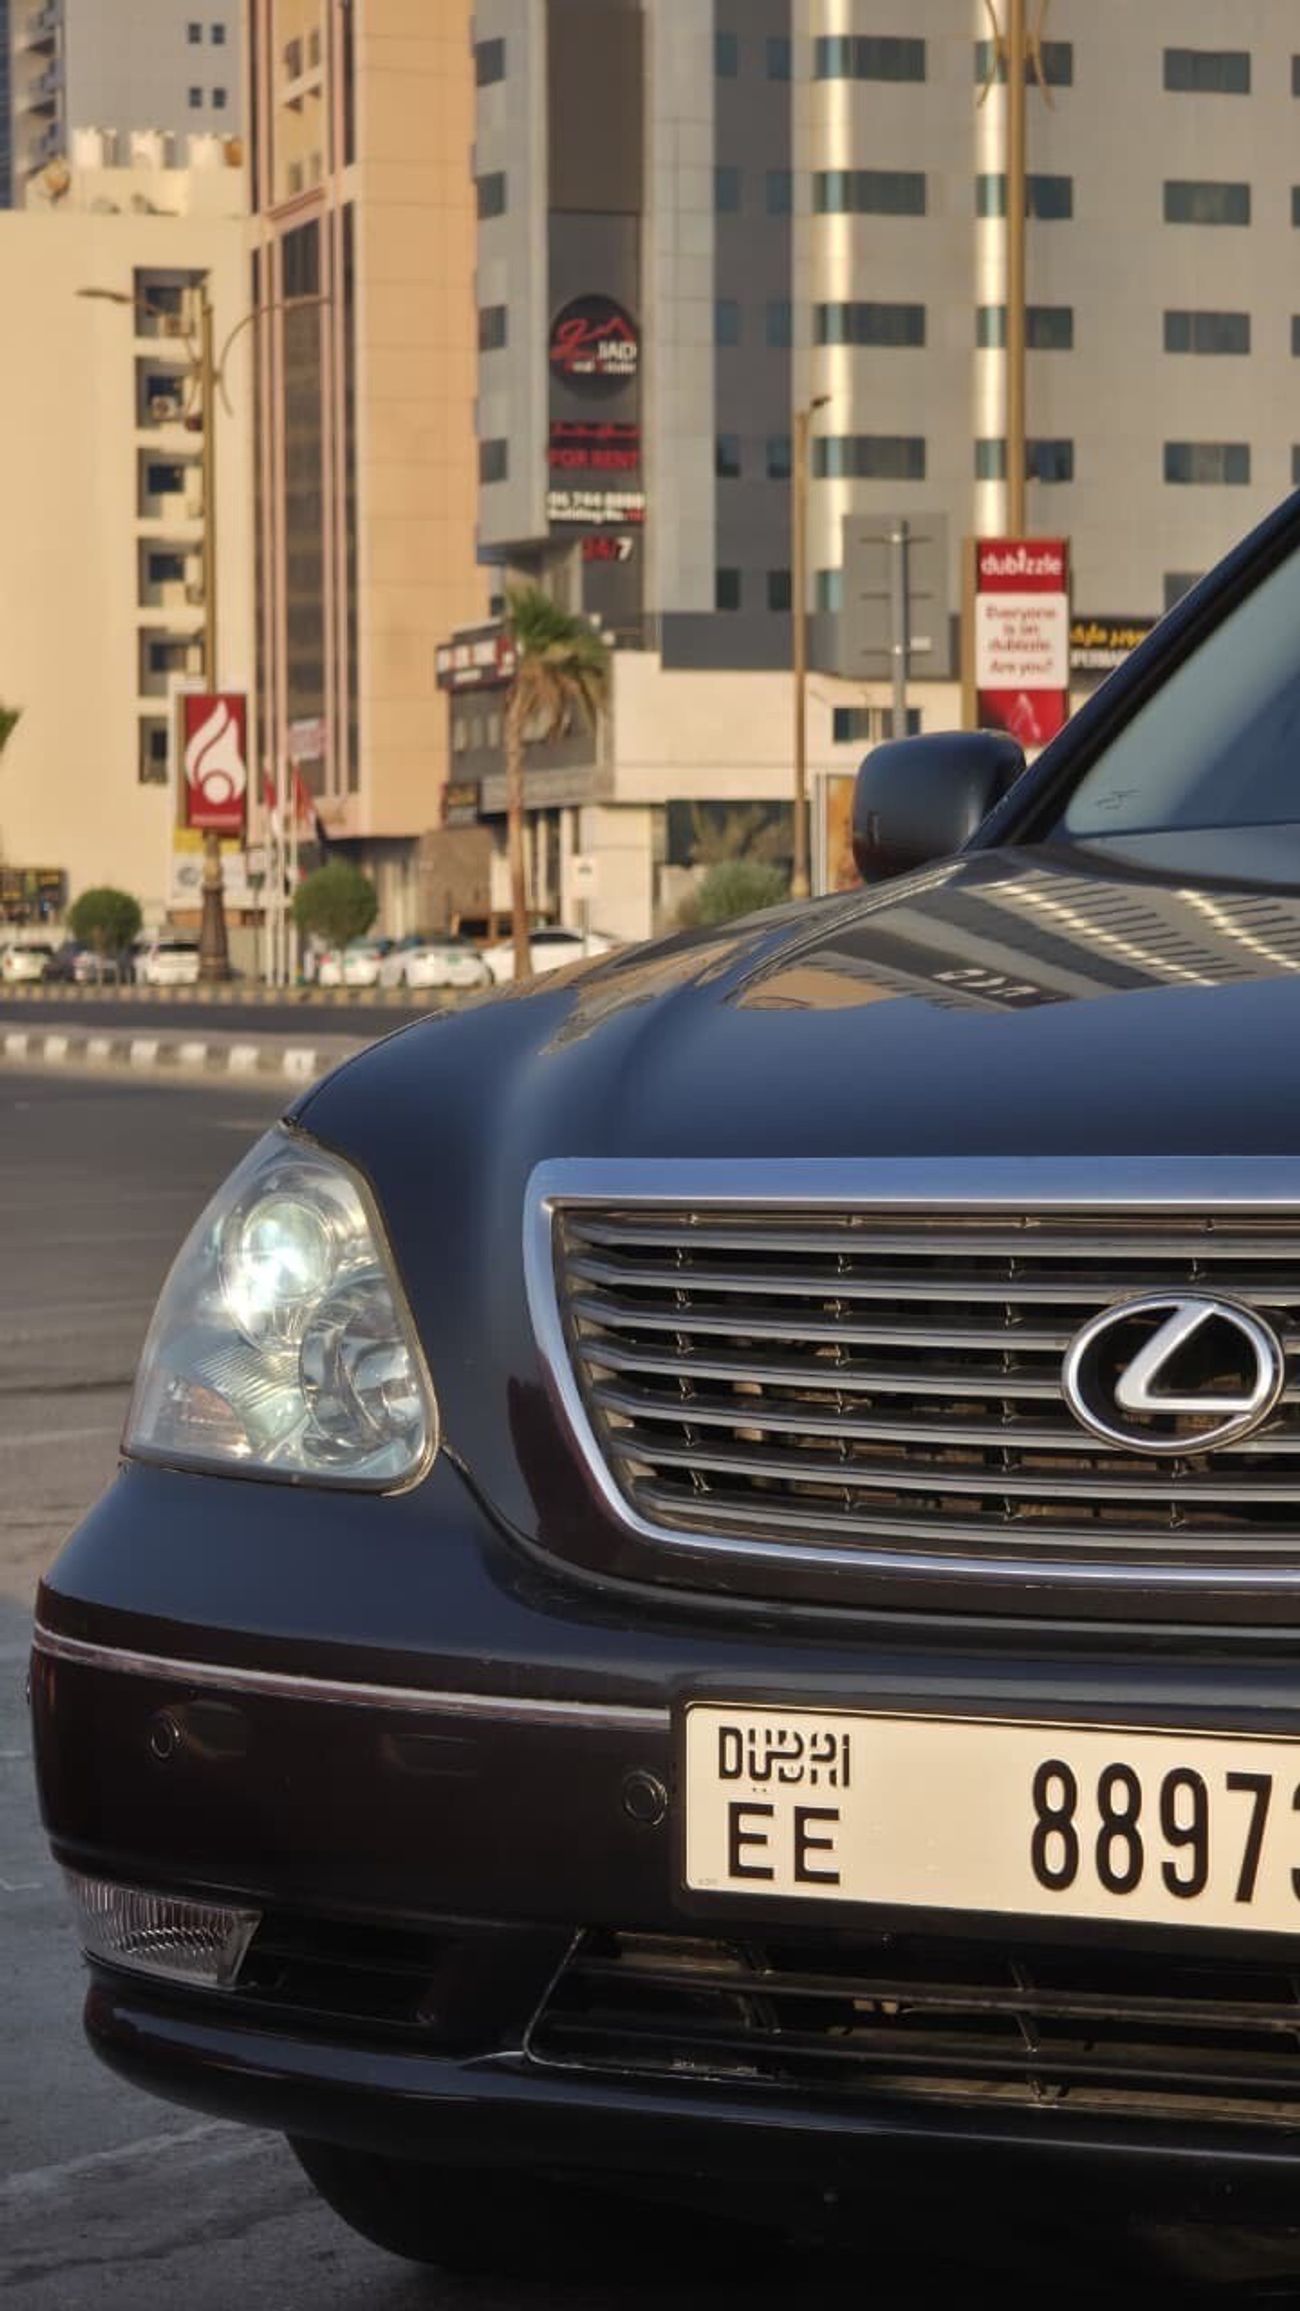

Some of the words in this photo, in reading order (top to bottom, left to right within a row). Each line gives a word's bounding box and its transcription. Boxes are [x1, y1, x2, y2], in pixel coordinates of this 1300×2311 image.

[548, 448, 588, 469] FOR
[591, 448, 639, 470] RENT
[980, 547, 1063, 576] dubizzle
[985, 605, 1056, 621] Everyone
[1020, 659, 1053, 677] you?
[729, 1801, 841, 1885] EE
[1031, 1759, 1300, 1904] 8897
